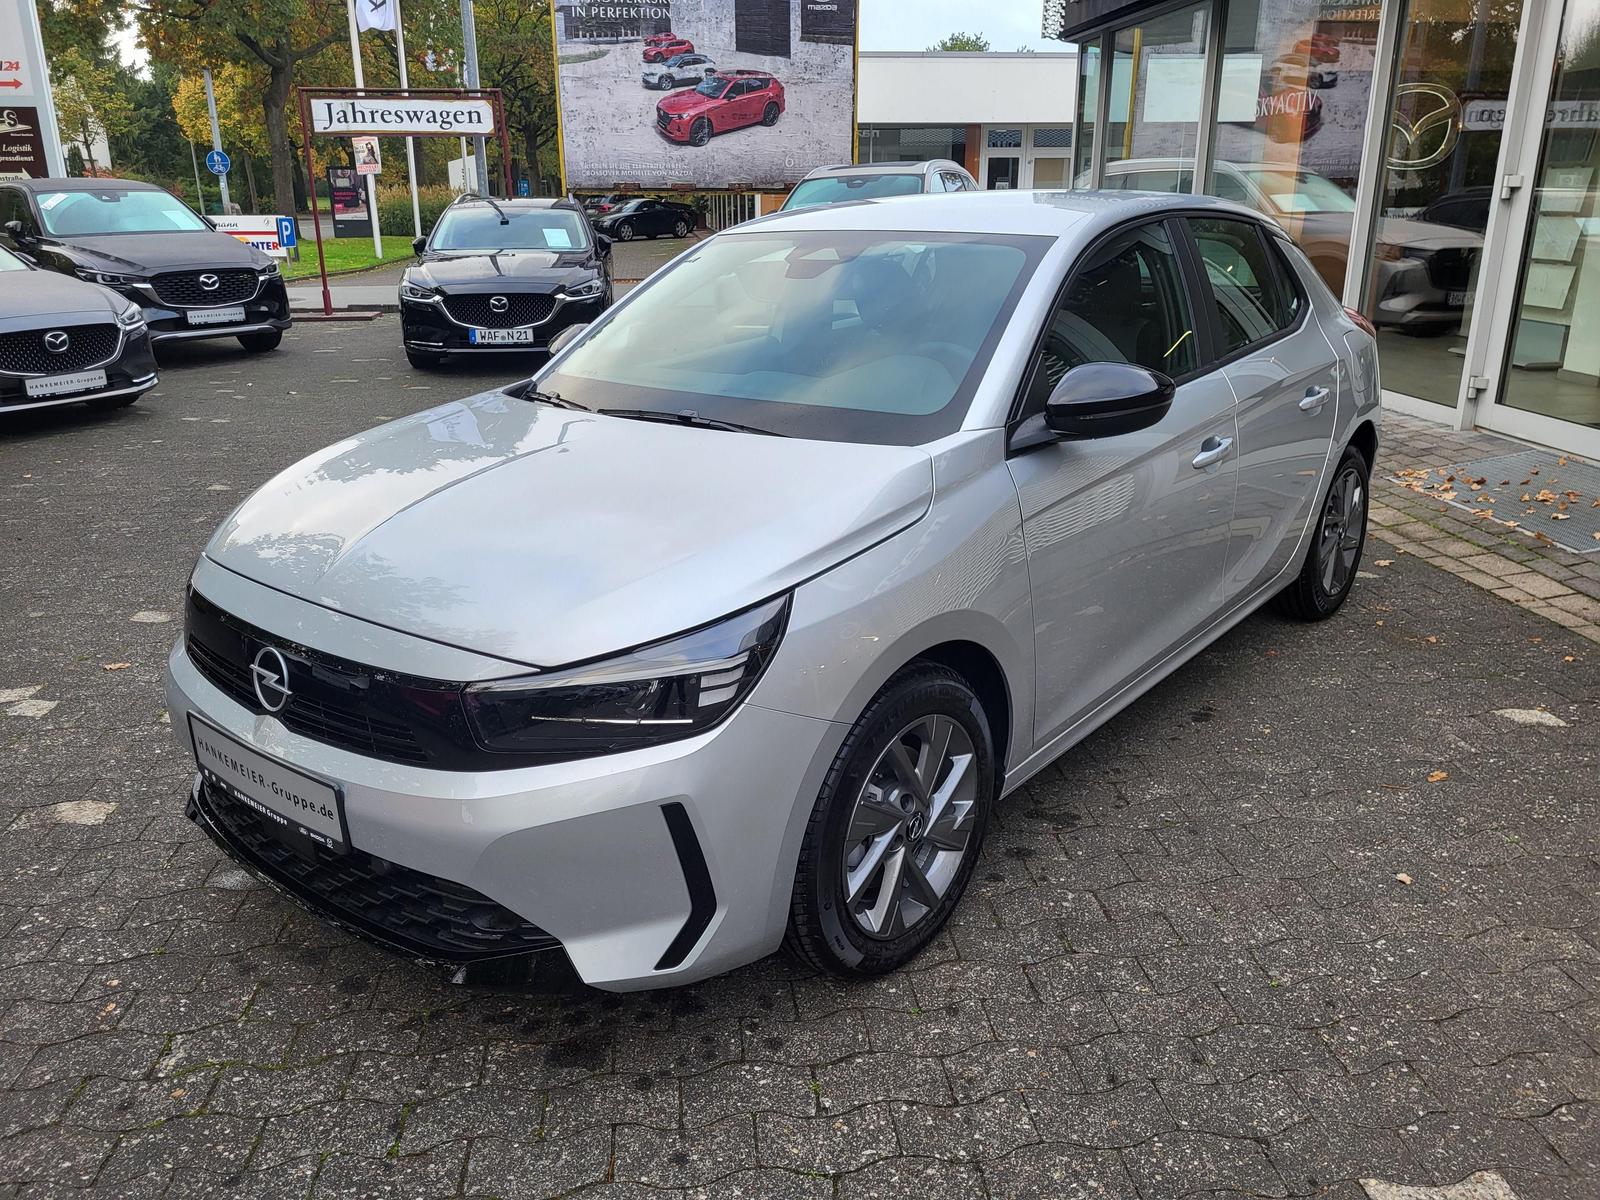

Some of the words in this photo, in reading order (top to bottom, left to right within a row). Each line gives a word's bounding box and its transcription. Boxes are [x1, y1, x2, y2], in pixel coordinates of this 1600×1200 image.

[571, 6, 586, 18] IN
[591, 6, 672, 19] PERFEKTION
[323, 101, 483, 130] Jahreswagen
[1255, 90, 1318, 117] SKYACTIV
[3, 144, 33, 153] Logistik
[281, 221, 291, 244] P
[480, 330, 500, 341] WAF
[197, 735, 334, 820] HANKEMEIER-Gruppe.de
[233, 789, 267, 814] HANKEMEIER
[266, 809, 288, 825] Gruppe
